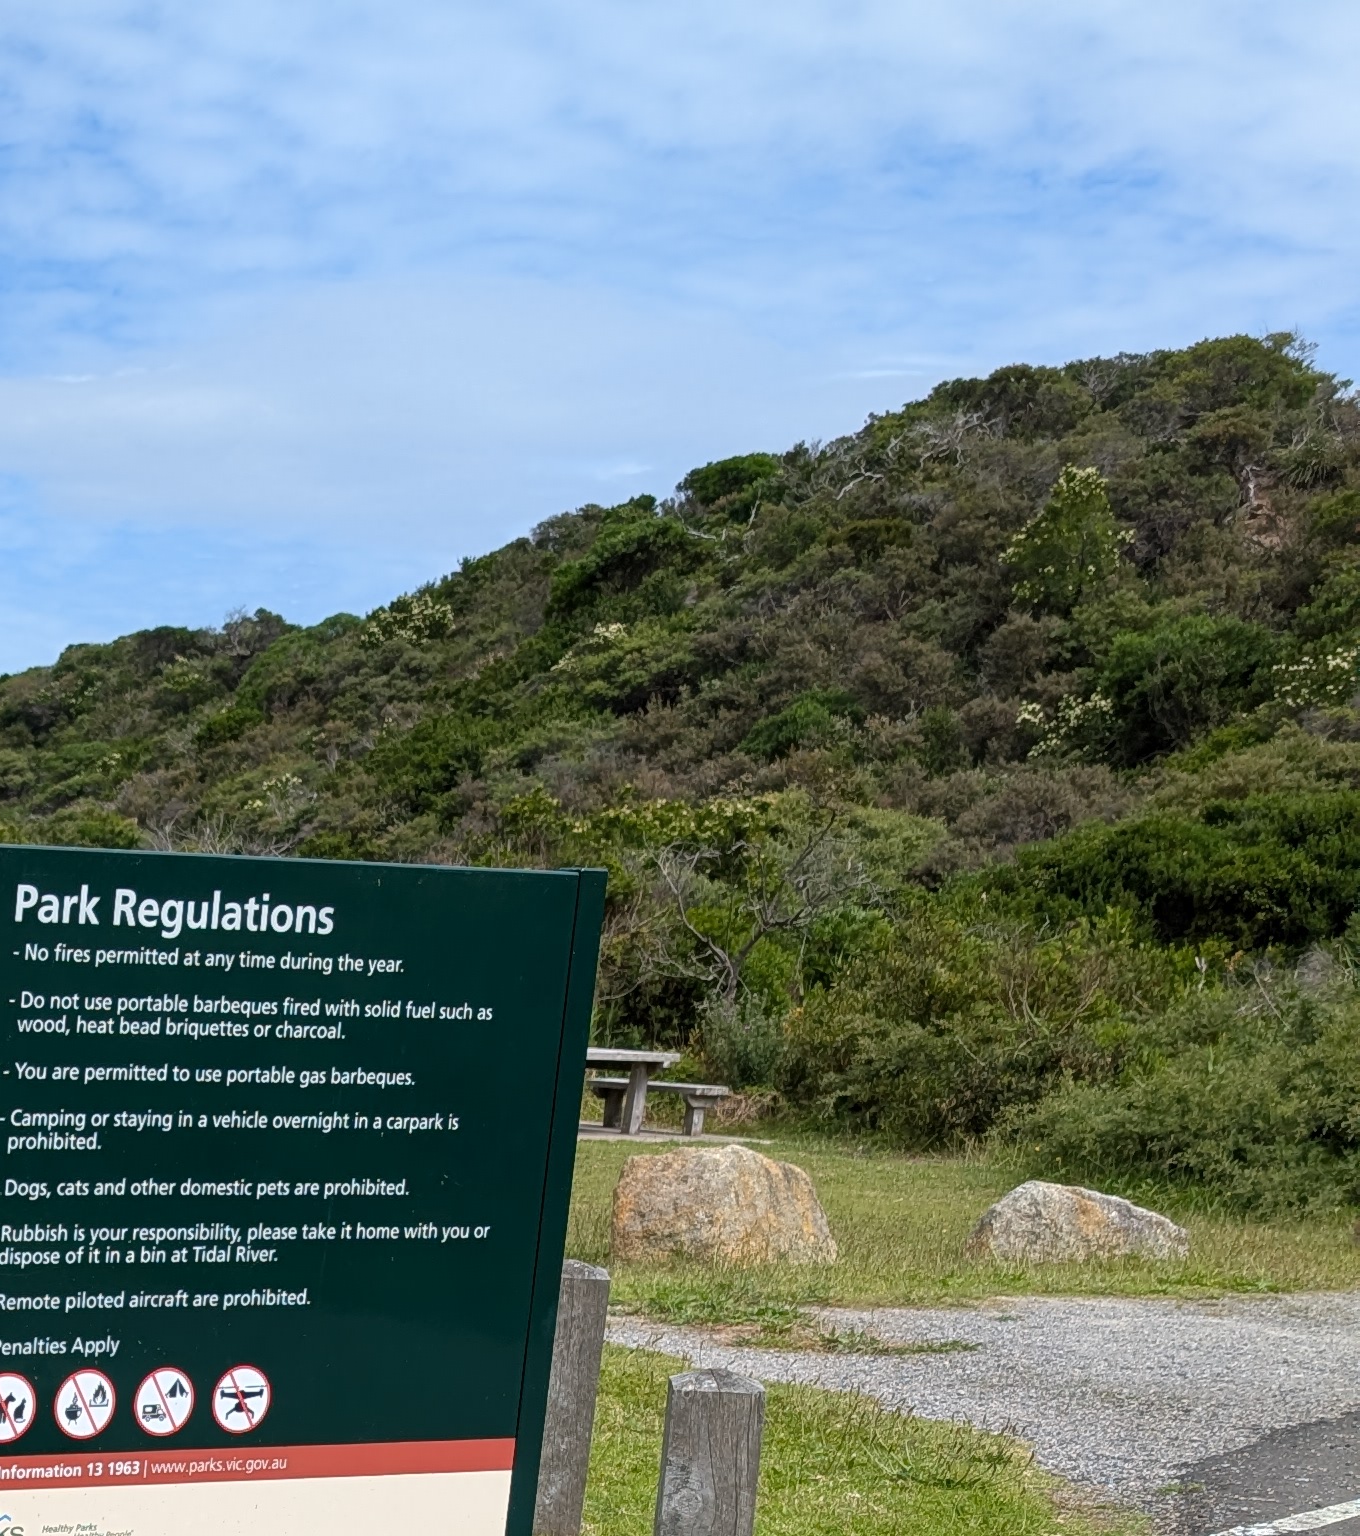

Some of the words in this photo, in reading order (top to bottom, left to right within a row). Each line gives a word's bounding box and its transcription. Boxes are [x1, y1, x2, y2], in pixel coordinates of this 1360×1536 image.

[14, 883, 101, 925] Park
[112, 888, 335, 939] Regulations
[24, 943, 49, 962] No
[53, 942, 91, 963] fires
[94, 946, 180, 968] permitted
[183, 950, 201, 967] at
[204, 953, 236, 972] any
[238, 950, 276, 969] time
[279, 951, 333, 976] during
[337, 953, 364, 972] the
[367, 959, 404, 977] year.
[20, 990, 45, 1009] Do
[50, 993, 80, 1010] not
[84, 996, 113, 1011] use
[116, 993, 189, 1018] portable
[193, 994, 278, 1019] barbeques
[282, 996, 321, 1017] fired
[324, 998, 360, 1017] with
[364, 999, 402, 1018] solid
[405, 1000, 436, 1019] fuel
[438, 1002, 473, 1020] such
[477, 1007, 493, 1021] as
[17, 1014, 71, 1036] wood,
[76, 1015, 115, 1035] heat
[119, 1015, 162, 1036] bead
[165, 1016, 250, 1040] briquettes
[253, 1024, 272, 1038] or
[275, 1020, 346, 1040] charcoal.
[14, 1062, 47, 1080] You
[51, 1066, 80, 1081] are
[84, 1063, 168, 1085] permitted
[172, 1065, 191, 1082] to
[195, 1068, 222, 1083] use
[226, 1065, 296, 1087] portable
[299, 1070, 327, 1089] gas
[330, 1066, 415, 1089] barbeques.
[10, 1108, 86, 1132] Camping
[90, 1113, 110, 1127] or
[113, 1109, 173, 1132] staying
[178, 1109, 193, 1128] in
[197, 1114, 208, 1128] a
[212, 1110, 268, 1129] vehicle
[272, 1111, 350, 1134] overnight
[354, 1111, 369, 1129] in
[372, 1116, 382, 1130] a
[386, 1112, 444, 1134] carpark
[448, 1113, 459, 1131] is
[7, 1131, 102, 1154] prohibited.
[4, 1178, 52, 1201] Dogs,
[56, 1180, 90, 1196] cats
[93, 1177, 127, 1196] and
[130, 1177, 177, 1196] other
[180, 1177, 253, 1196] domestic
[256, 1180, 290, 1200] pets
[293, 1182, 320, 1196] are
[323, 1178, 410, 1200] prohibited.
[0, 1223, 68, 1243] Rubbish
[73, 1223, 86, 1242] is
[88, 1227, 129, 1246] your
[132, 1222, 242, 1245] responsibility,
[246, 1222, 298, 1245] please
[301, 1222, 337, 1240] take
[340, 1221, 353, 1240] it
[355, 1222, 400, 1240] home
[403, 1222, 438, 1239] with
[440, 1226, 470, 1243] you
[473, 1226, 491, 1239] or
[65, 1245, 85, 1265] of
[88, 1246, 101, 1264] it
[105, 1245, 121, 1264] in
[125, 1250, 135, 1264] a
[140, 1245, 166, 1264] bin
[170, 1247, 189, 1263] at
[192, 1245, 232, 1263] Tidal
[235, 1245, 278, 1263] River.
[64, 1290, 125, 1314] piloted
[128, 1289, 189, 1308] aircraft
[192, 1293, 219, 1307] are
[222, 1287, 311, 1311] prohibited.
[70, 1335, 121, 1358] Apply
[87, 1461, 103, 1478] 13
[107, 1460, 140, 1476] 1963
[150, 1456, 288, 1476] www.parks.vic.gov.au
[42, 1524, 74, 1535] Healthy
[75, 1522, 98, 1532] Parks
